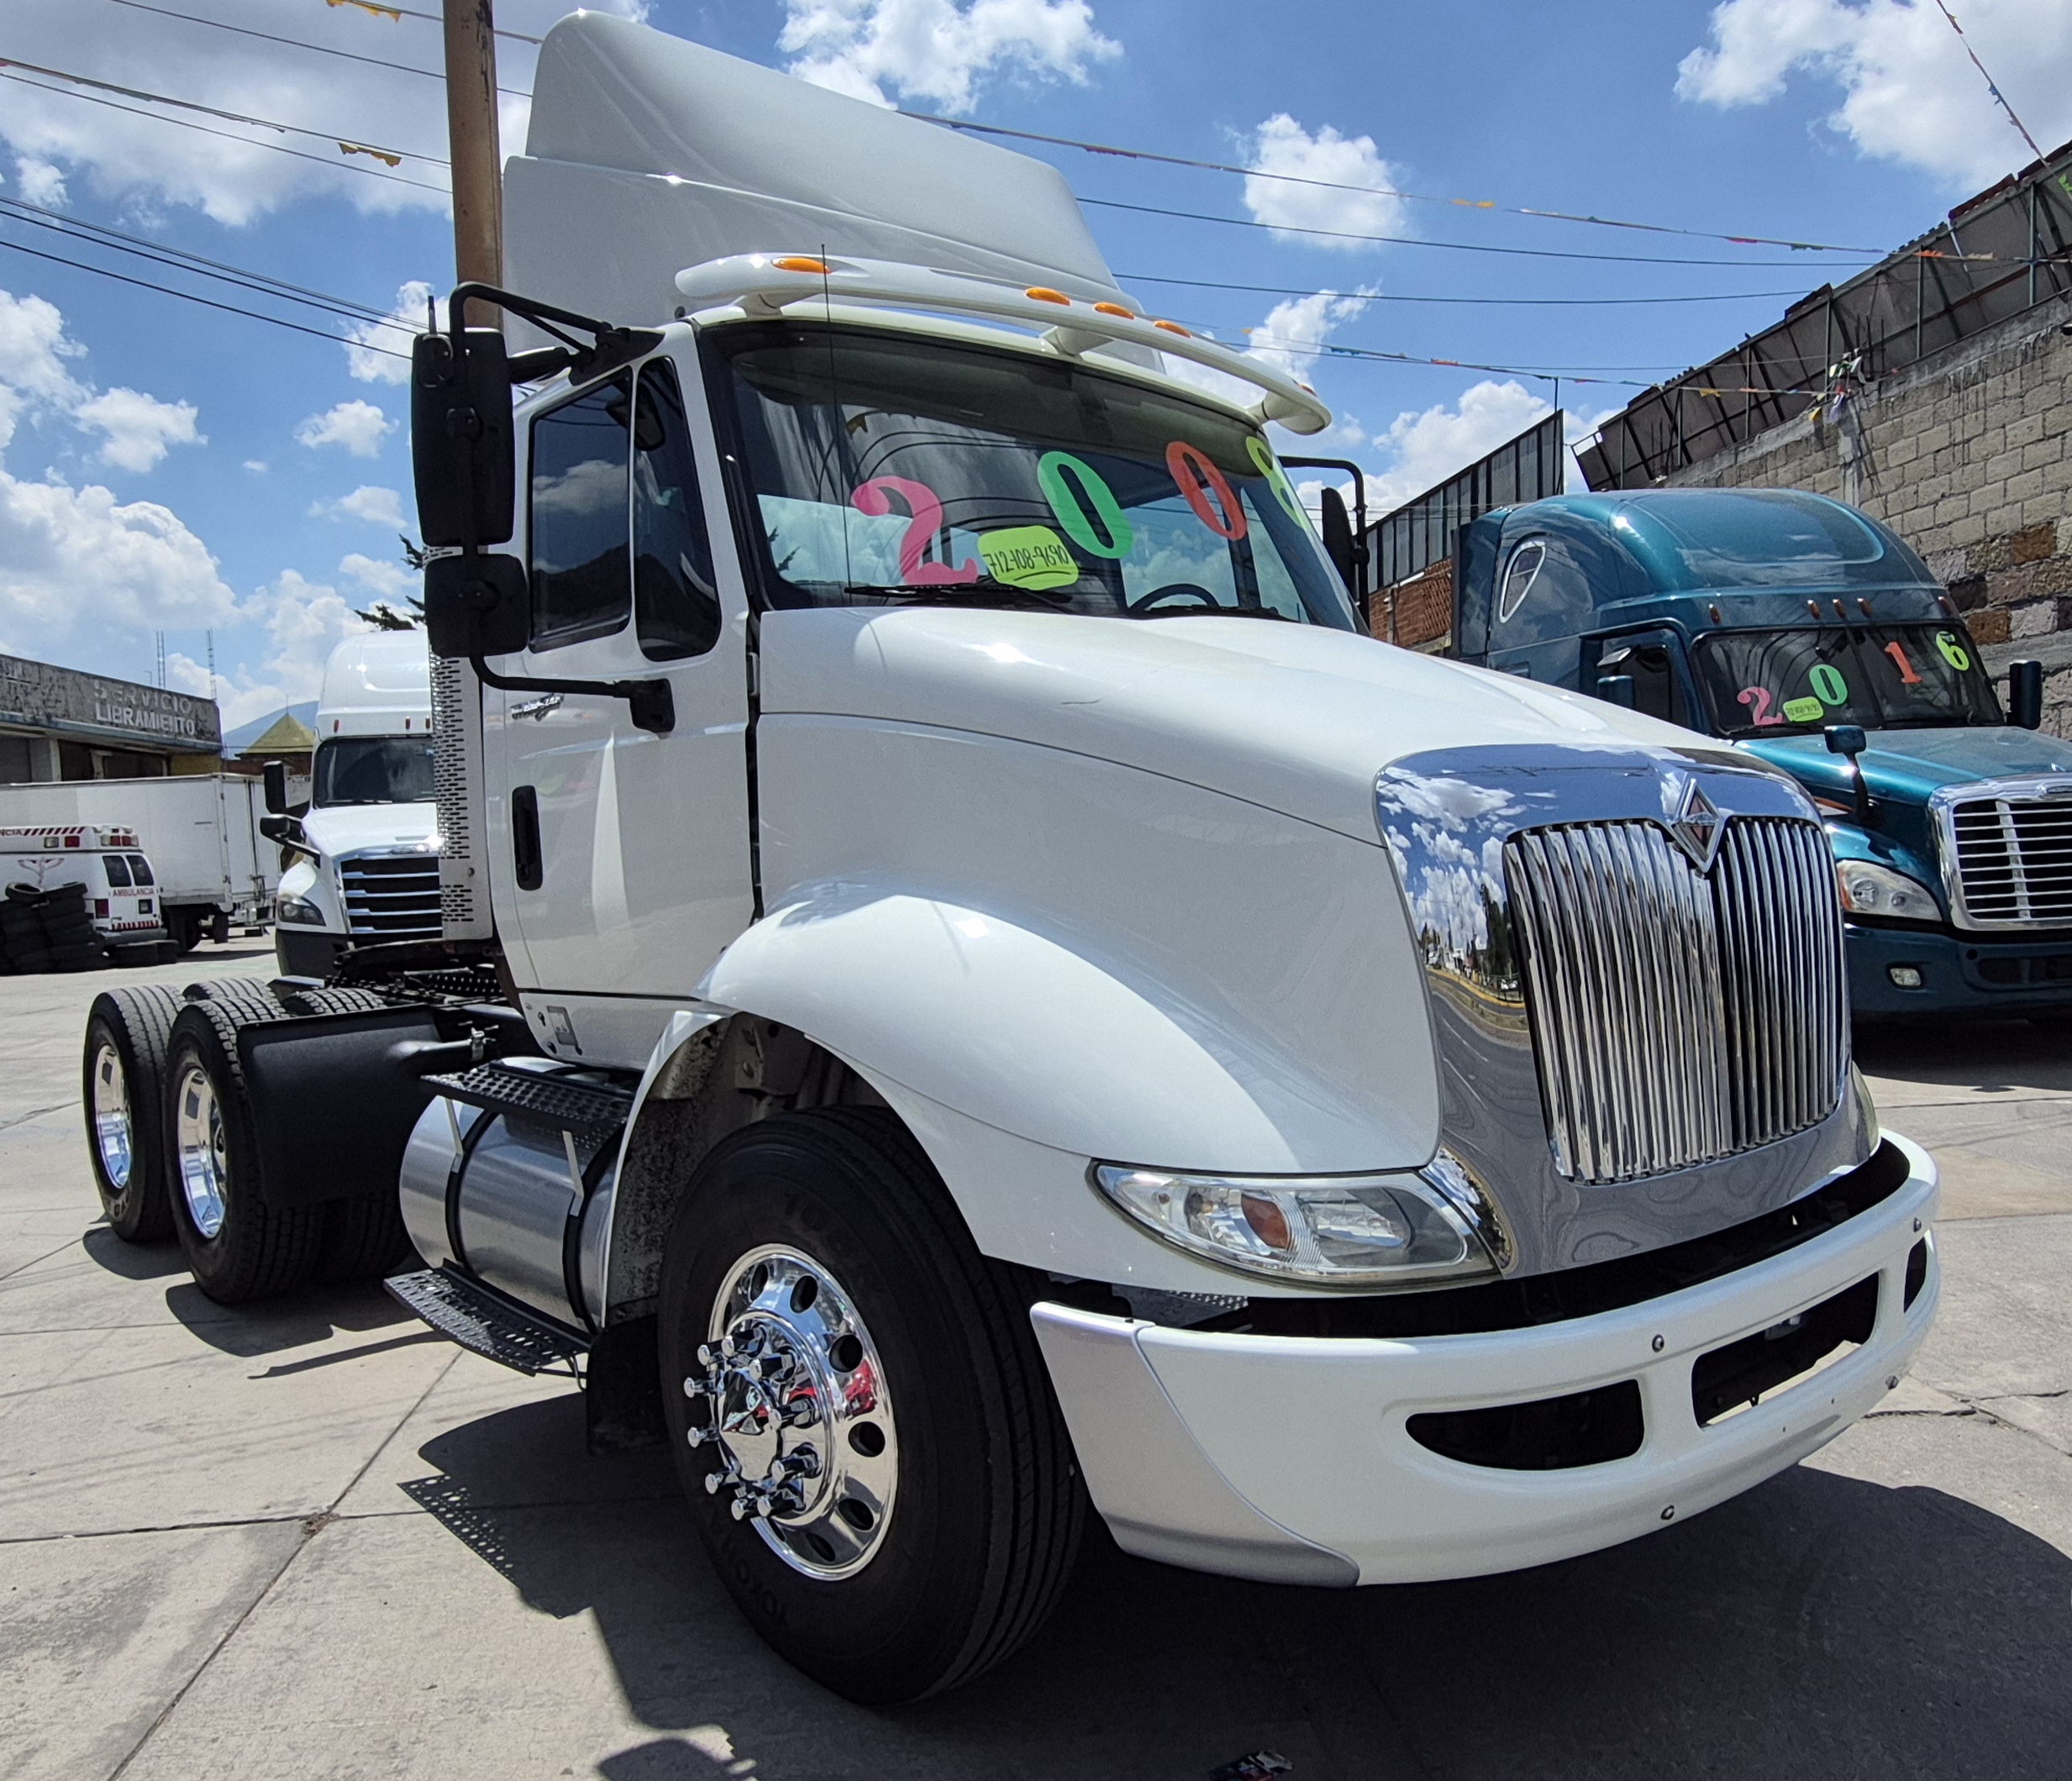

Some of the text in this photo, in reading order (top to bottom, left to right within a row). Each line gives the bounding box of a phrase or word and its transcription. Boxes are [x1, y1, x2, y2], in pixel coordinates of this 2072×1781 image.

[982, 544, 1070, 577] 712-108-9690
[93, 679, 192, 714] SERVICIO
[95, 701, 195, 736] LIBRAMIENTO
[112, 889, 155, 897] AMBULANCIA
